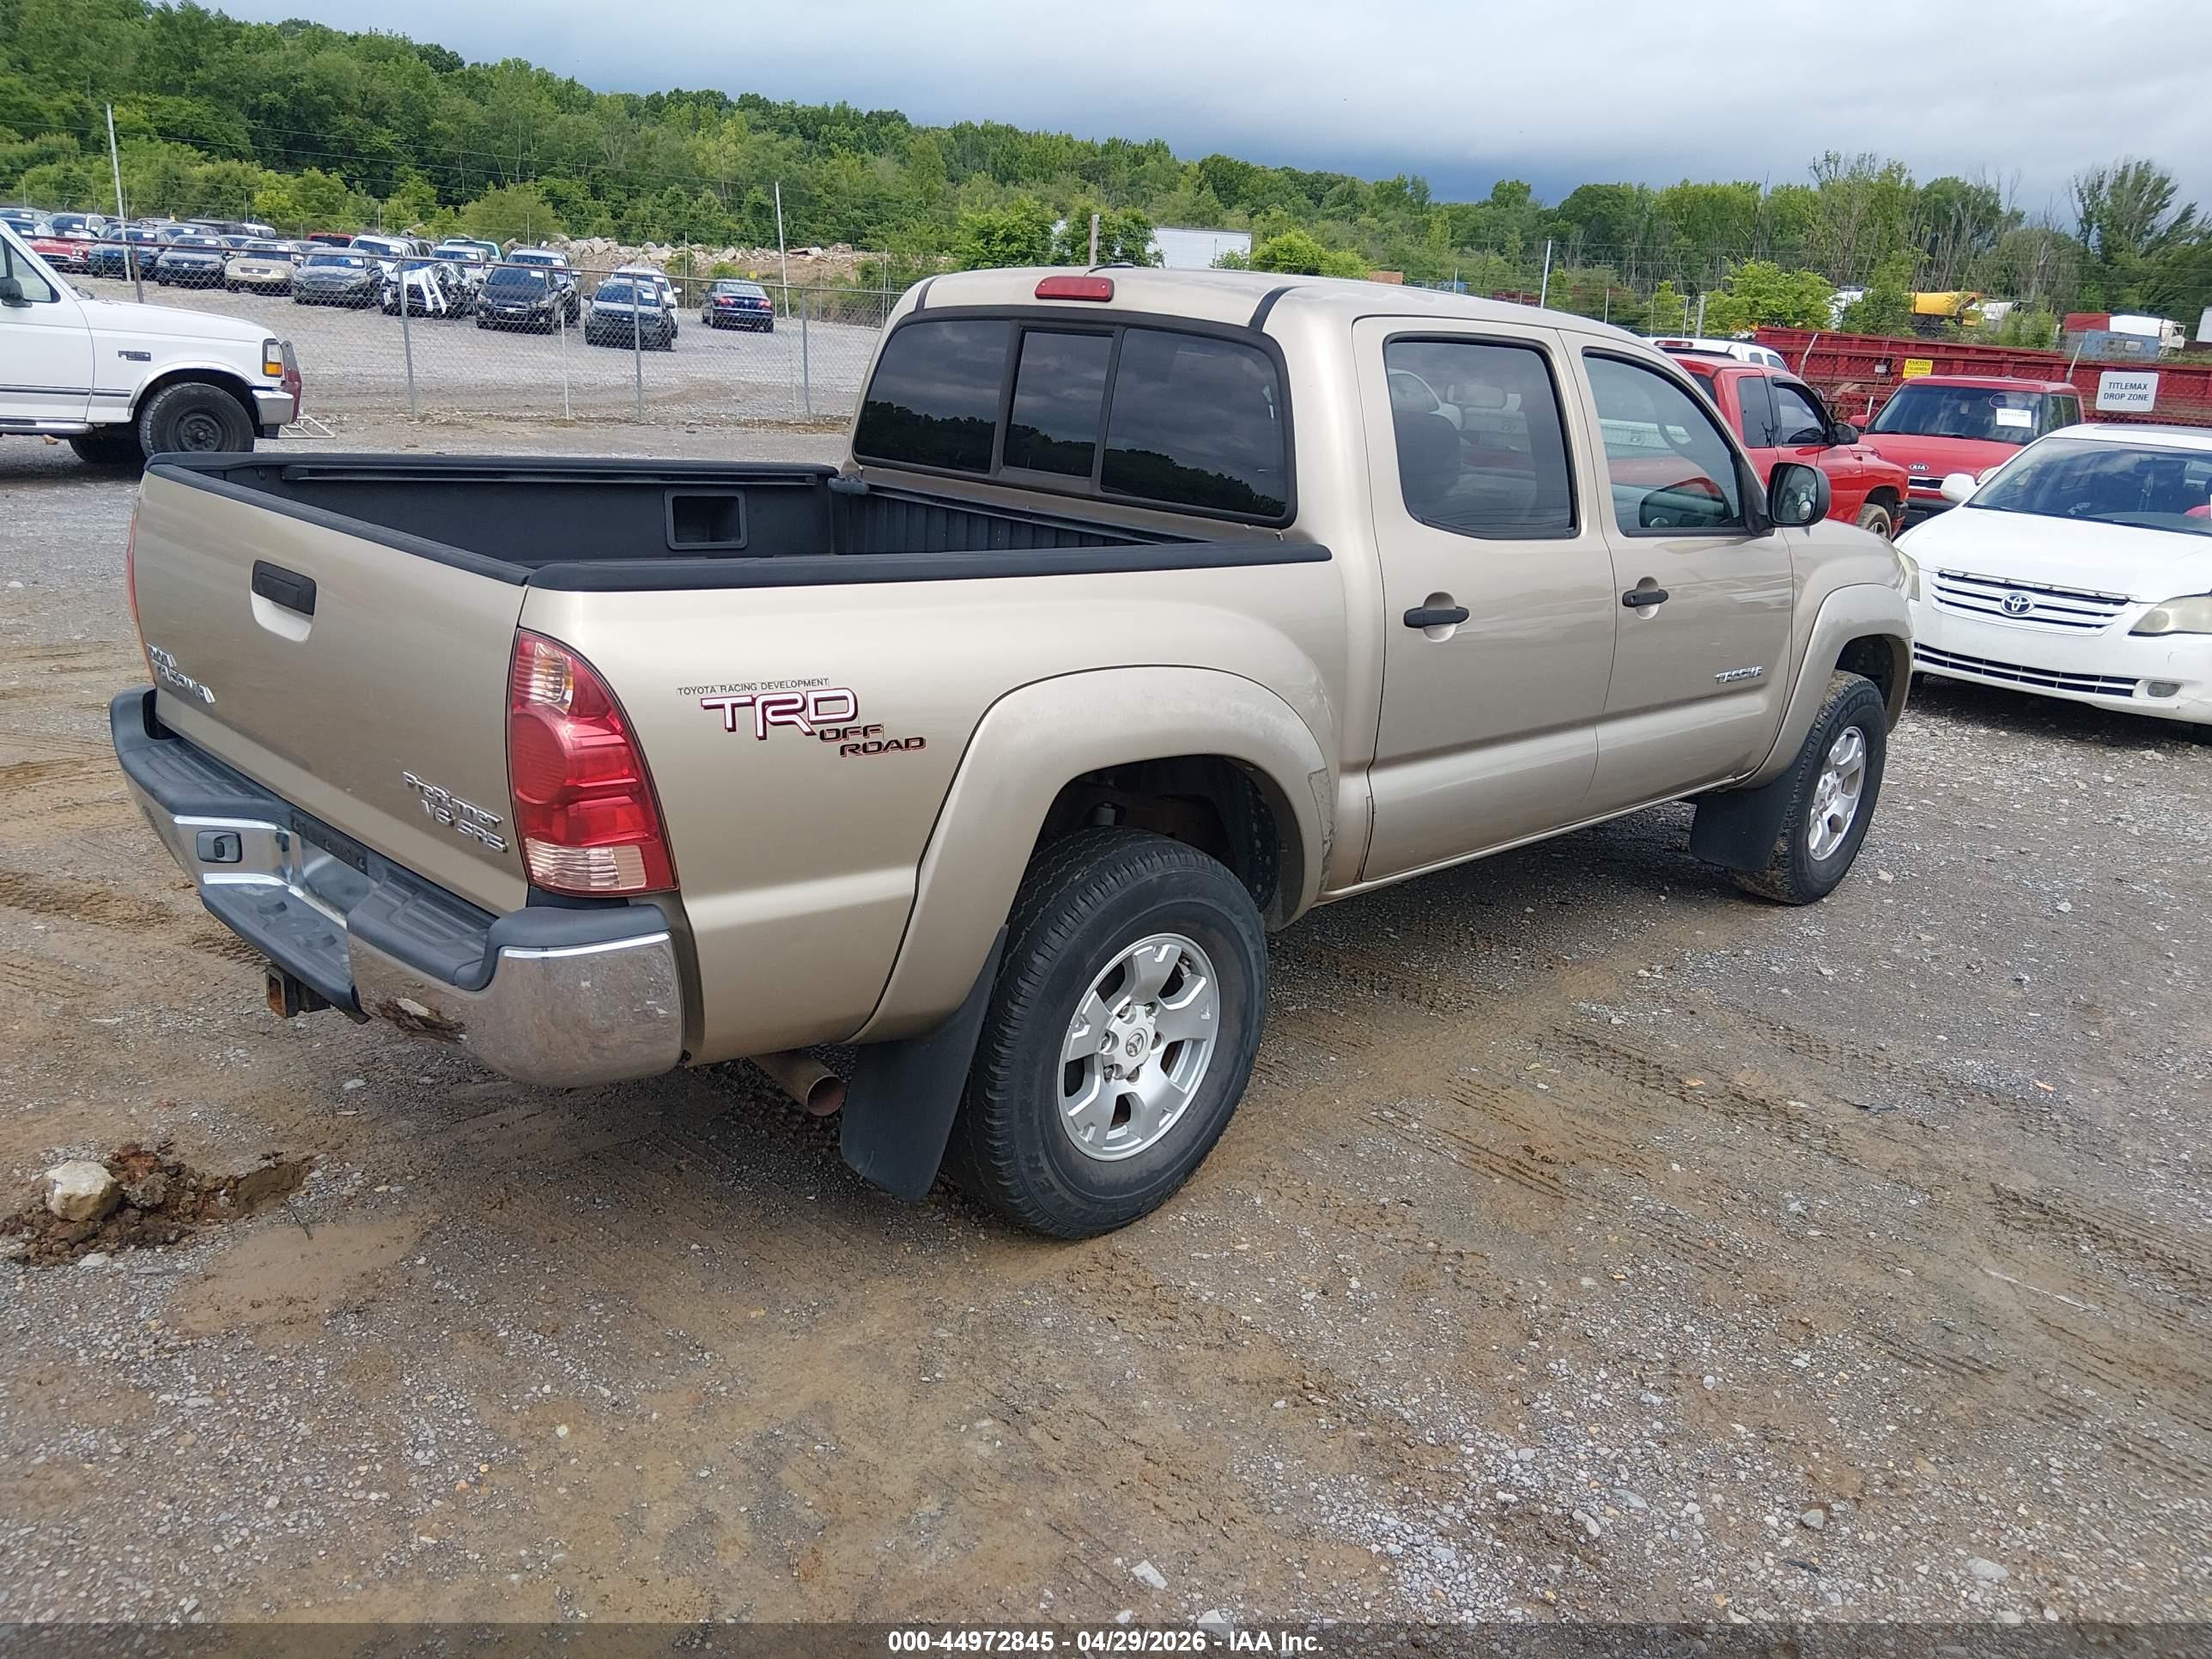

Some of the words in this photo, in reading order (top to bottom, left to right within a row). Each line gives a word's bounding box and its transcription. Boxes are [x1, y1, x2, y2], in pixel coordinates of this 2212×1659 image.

[2108, 381, 2148, 391] TITLEMAX
[2103, 392, 2125, 401] DROP
[2127, 393, 2149, 402] ZONE
[678, 685, 717, 696] TOYOTA
[720, 682, 758, 694] RACING
[761, 678, 829, 690] DEVELOPMENT
[700, 687, 859, 741] TRD
[819, 723, 884, 743] OFF
[840, 736, 927, 757] ROAD
